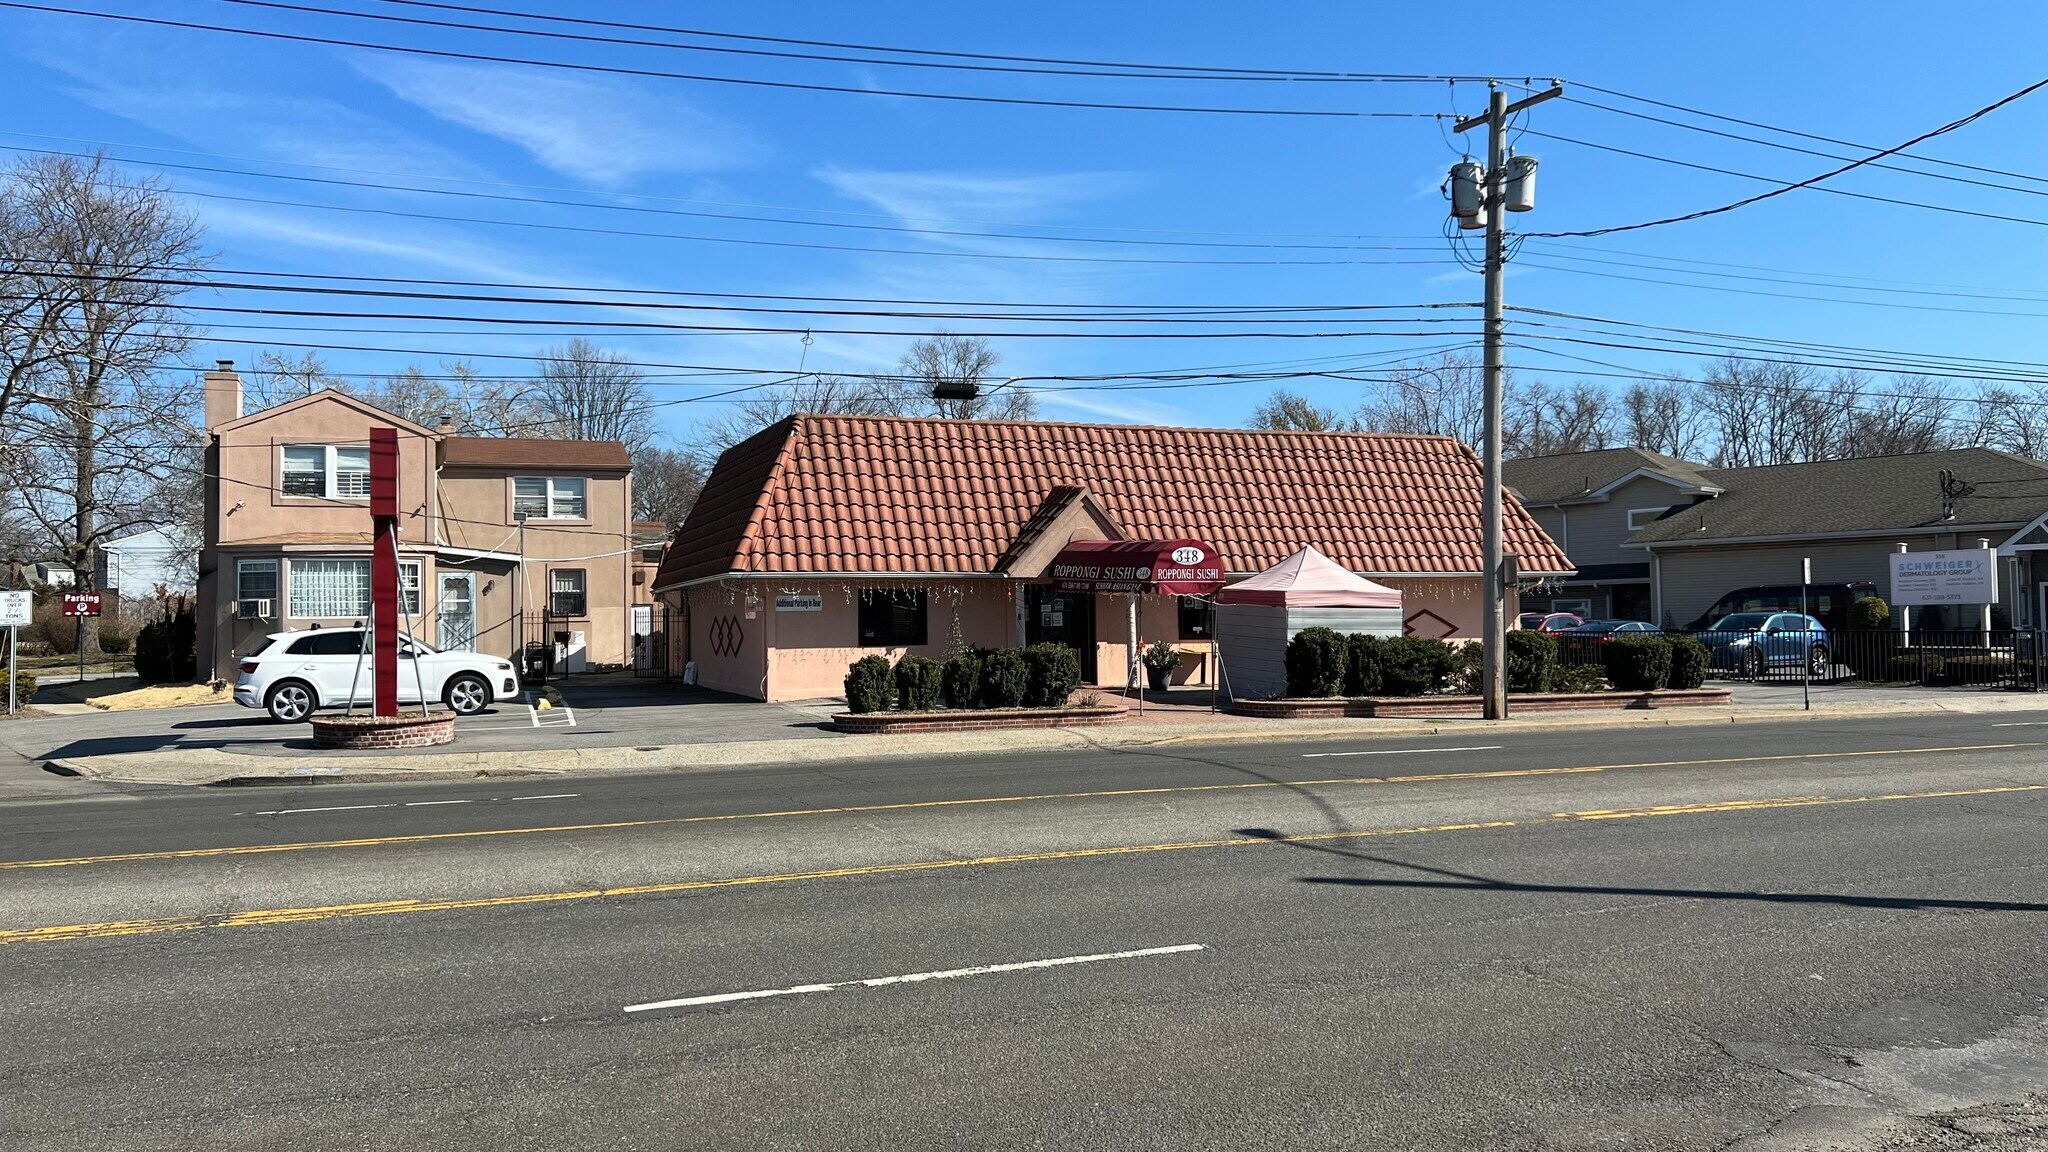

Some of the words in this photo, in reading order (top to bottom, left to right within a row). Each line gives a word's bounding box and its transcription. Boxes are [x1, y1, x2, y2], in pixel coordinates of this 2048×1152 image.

[1176, 549, 1199, 563] 348
[1899, 560, 1973, 570] SCHWEIGER
[1054, 564, 1100, 579] ROPPONGI
[1103, 566, 1136, 580] SUSHI
[1158, 568, 1194, 580] ROPPONGI
[1197, 568, 1219, 579] SUSHI
[1899, 570, 1948, 578] DERMATOLOGY
[64, 594, 100, 603] Parking
[794, 599, 808, 609] Parking
[812, 599, 821, 607] Rear
